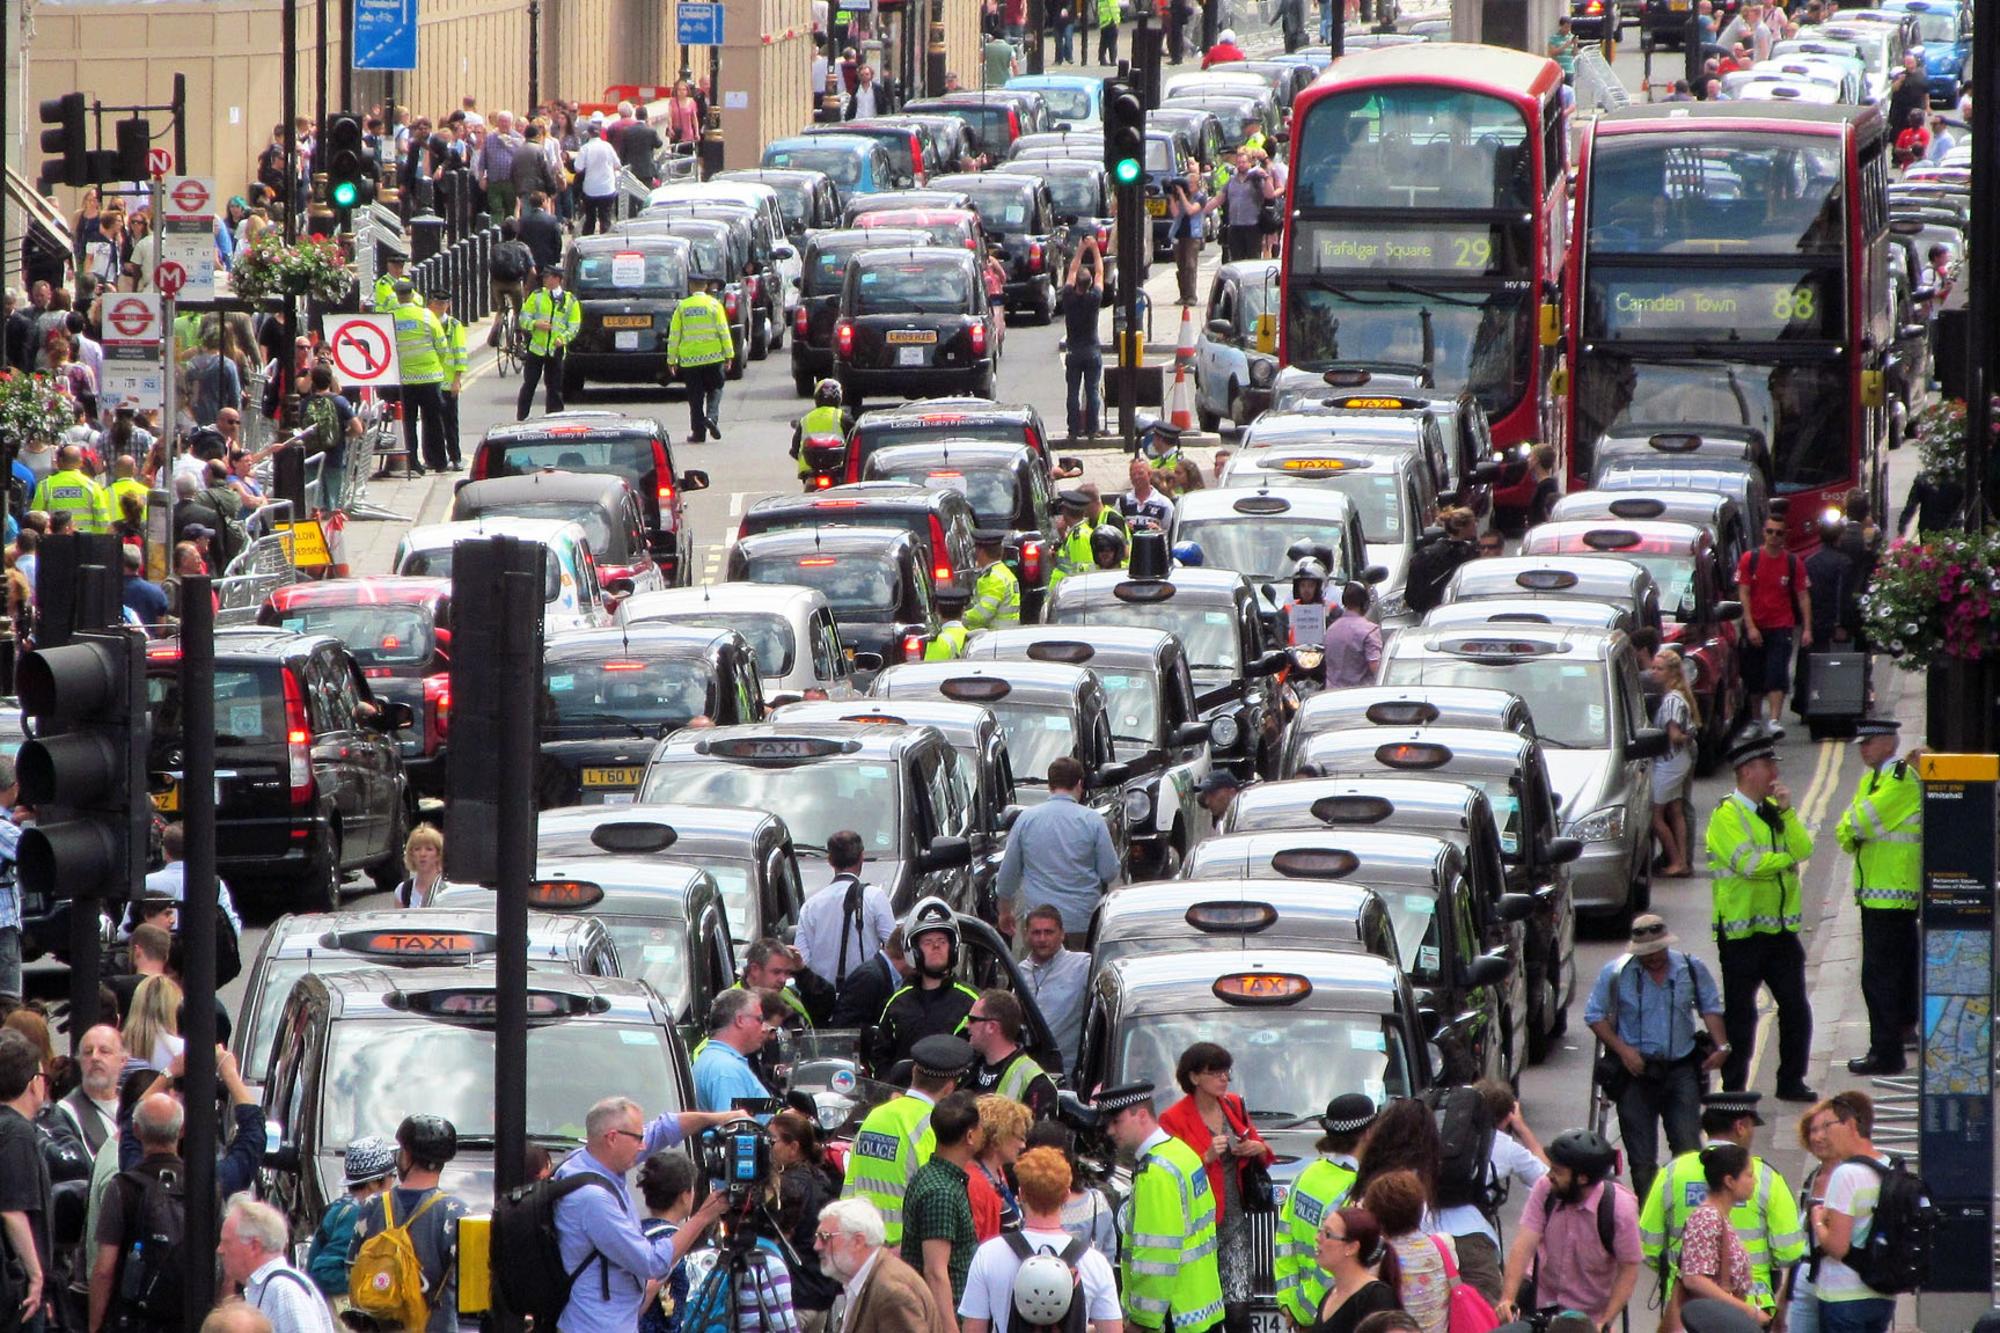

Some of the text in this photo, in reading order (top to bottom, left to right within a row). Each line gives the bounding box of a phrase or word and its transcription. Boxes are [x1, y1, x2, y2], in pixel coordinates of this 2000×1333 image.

[149, 152, 166, 171] N
[1321, 238, 1491, 267] Trafalgar Square 29
[160, 267, 180, 288] M
[1505, 281, 1531, 289] HV 97
[1616, 287, 1815, 320] Camden Town 88
[1360, 401, 1392, 409] TAXI
[1296, 460, 1333, 469] TAXI
[750, 742, 800, 754] TAXI
[588, 769, 624, 783] LT60
[390, 936, 454, 950] TAXI
[1236, 976, 1290, 995] TAXI
[464, 996, 535, 1010] TAI
